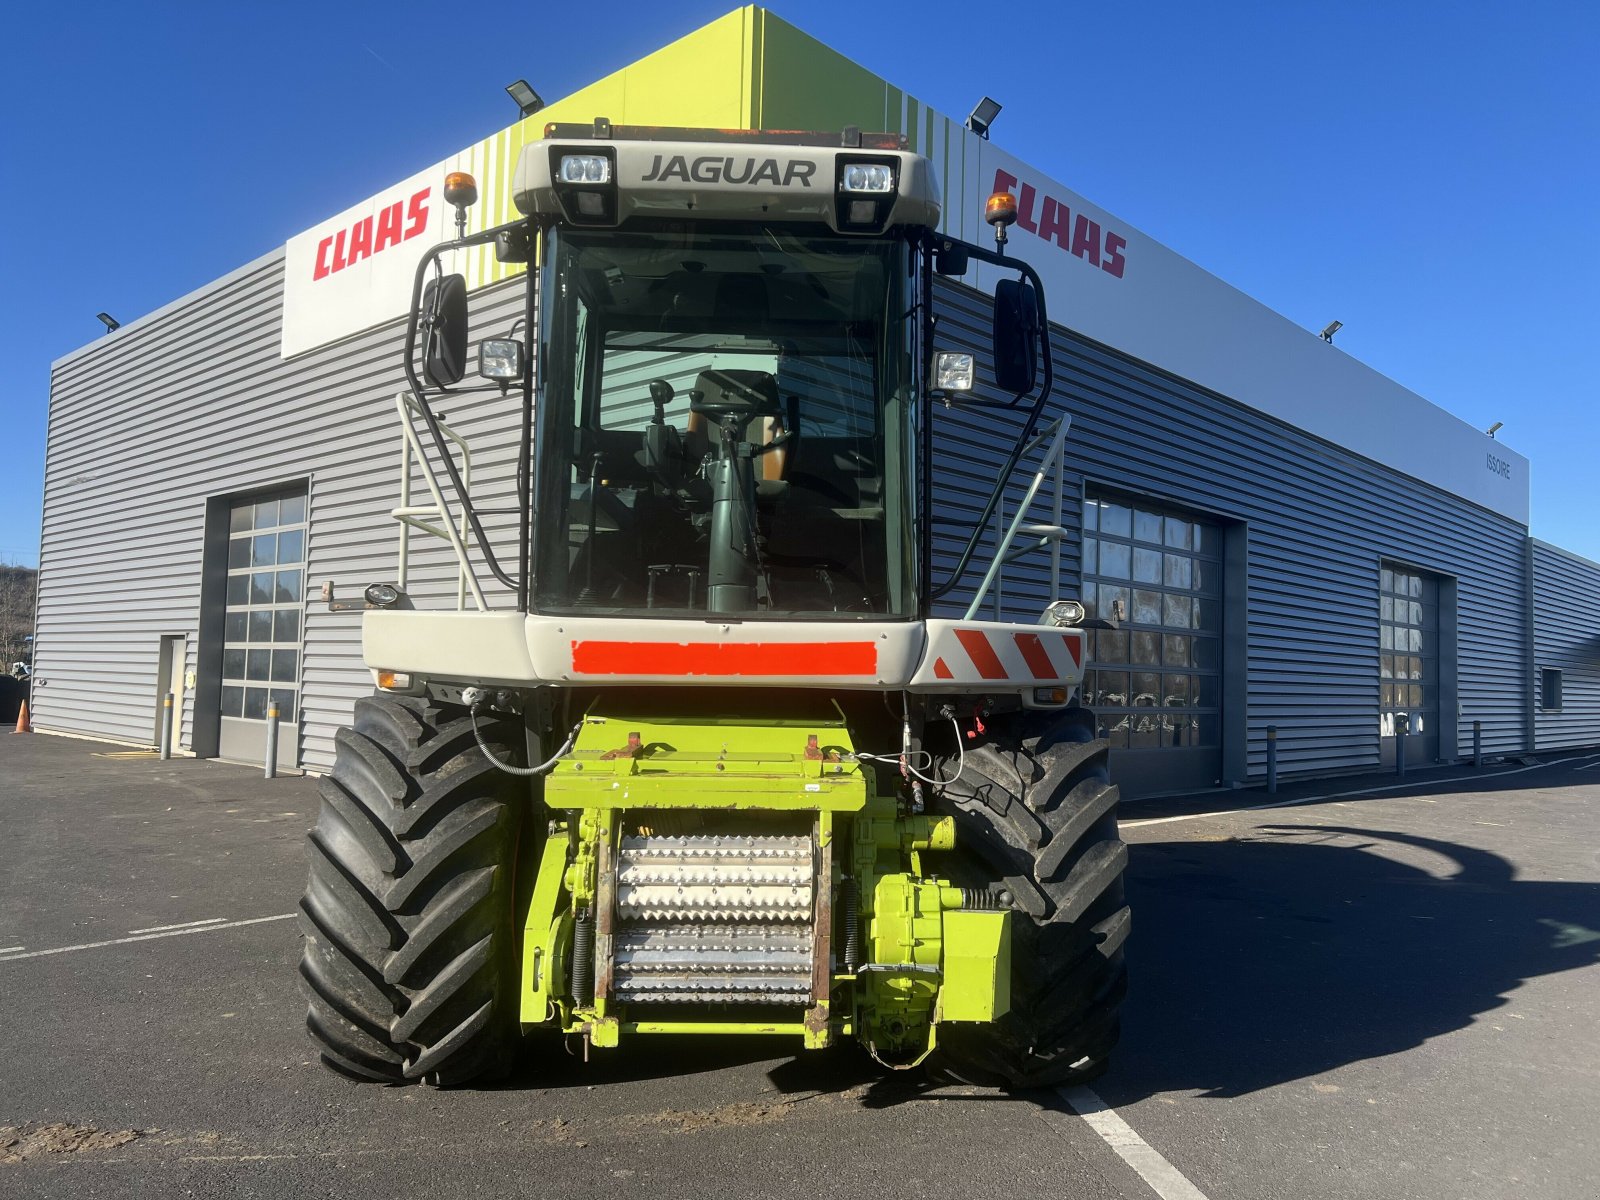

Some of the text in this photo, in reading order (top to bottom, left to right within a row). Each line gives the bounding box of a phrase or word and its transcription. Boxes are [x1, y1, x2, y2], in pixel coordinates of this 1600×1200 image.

[641, 155, 817, 187] JAGUAR
[313, 186, 431, 281] CLAAS
[1486, 452, 1511, 480] ISSOIRE
